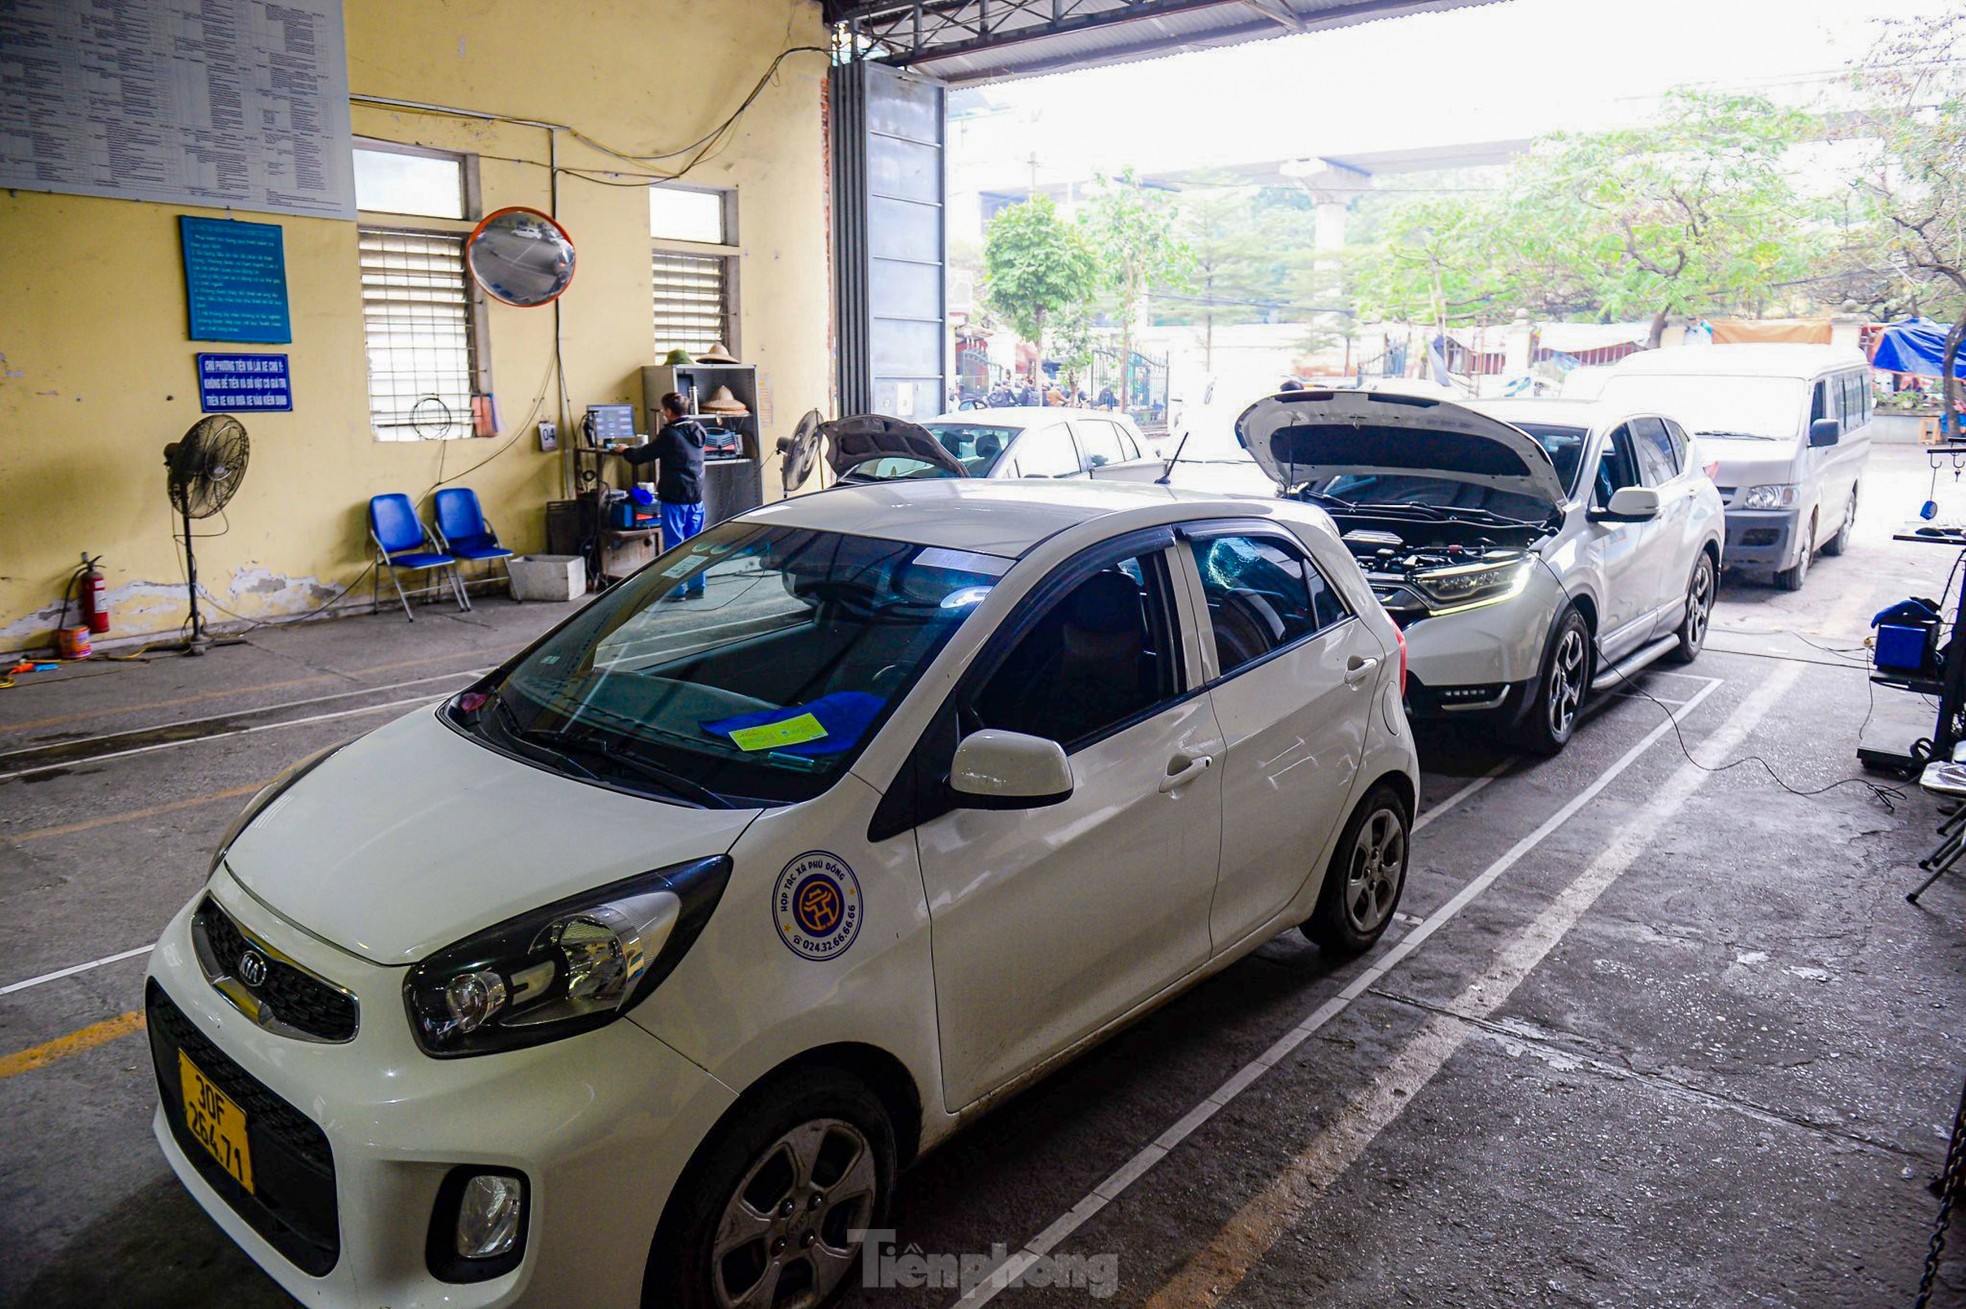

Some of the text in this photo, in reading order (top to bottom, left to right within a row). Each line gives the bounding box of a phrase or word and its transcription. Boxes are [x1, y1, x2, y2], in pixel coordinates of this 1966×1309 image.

[543, 428, 555, 440] 04
[196, 1074, 225, 1125] 30F
[189, 1101, 243, 1182] 264.71
